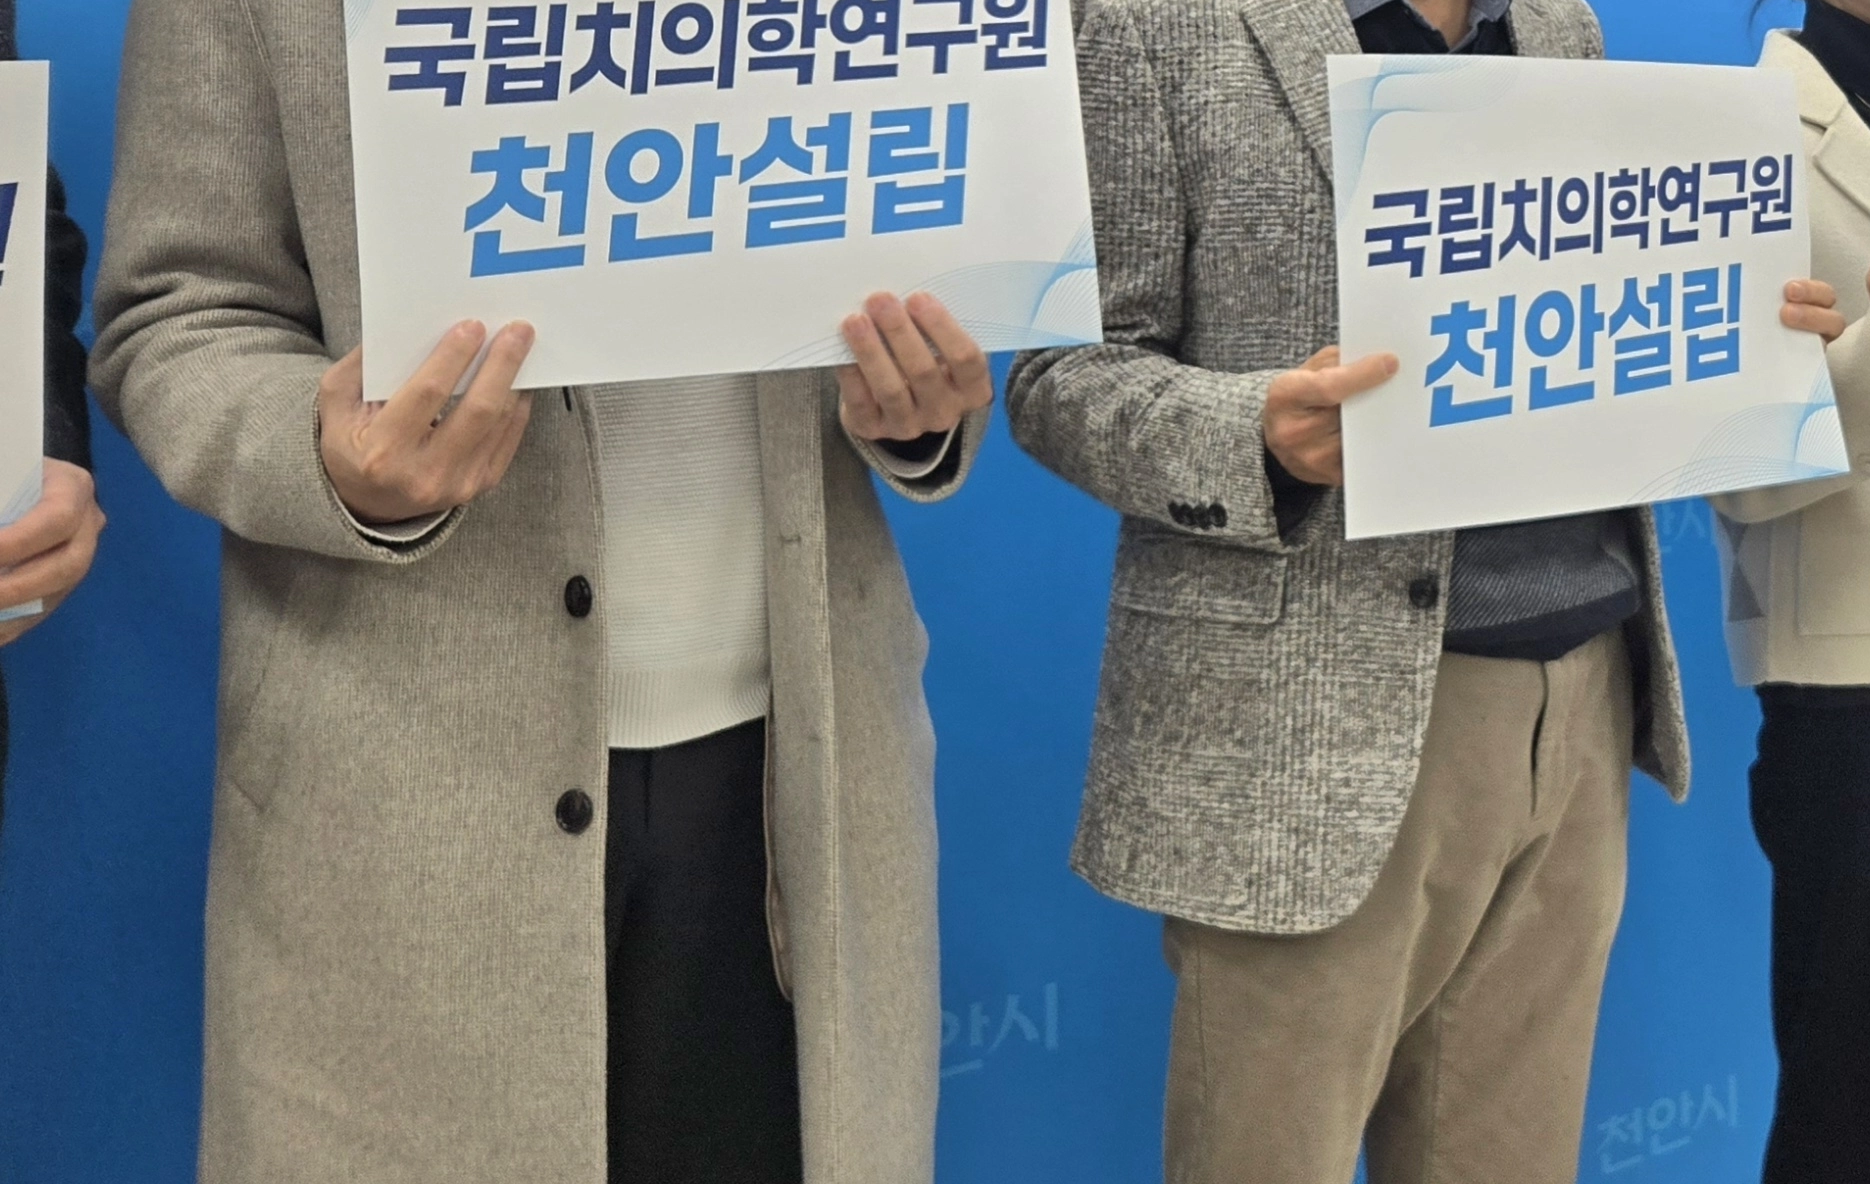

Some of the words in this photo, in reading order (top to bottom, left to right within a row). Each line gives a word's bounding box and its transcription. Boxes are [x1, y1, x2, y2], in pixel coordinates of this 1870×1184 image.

[463, 102, 969, 278] 천안설립
[1364, 154, 1794, 278] 국립치의학연구원
[1424, 263, 1744, 428] 천안설립
[1595, 1073, 1741, 1174] 천안시
